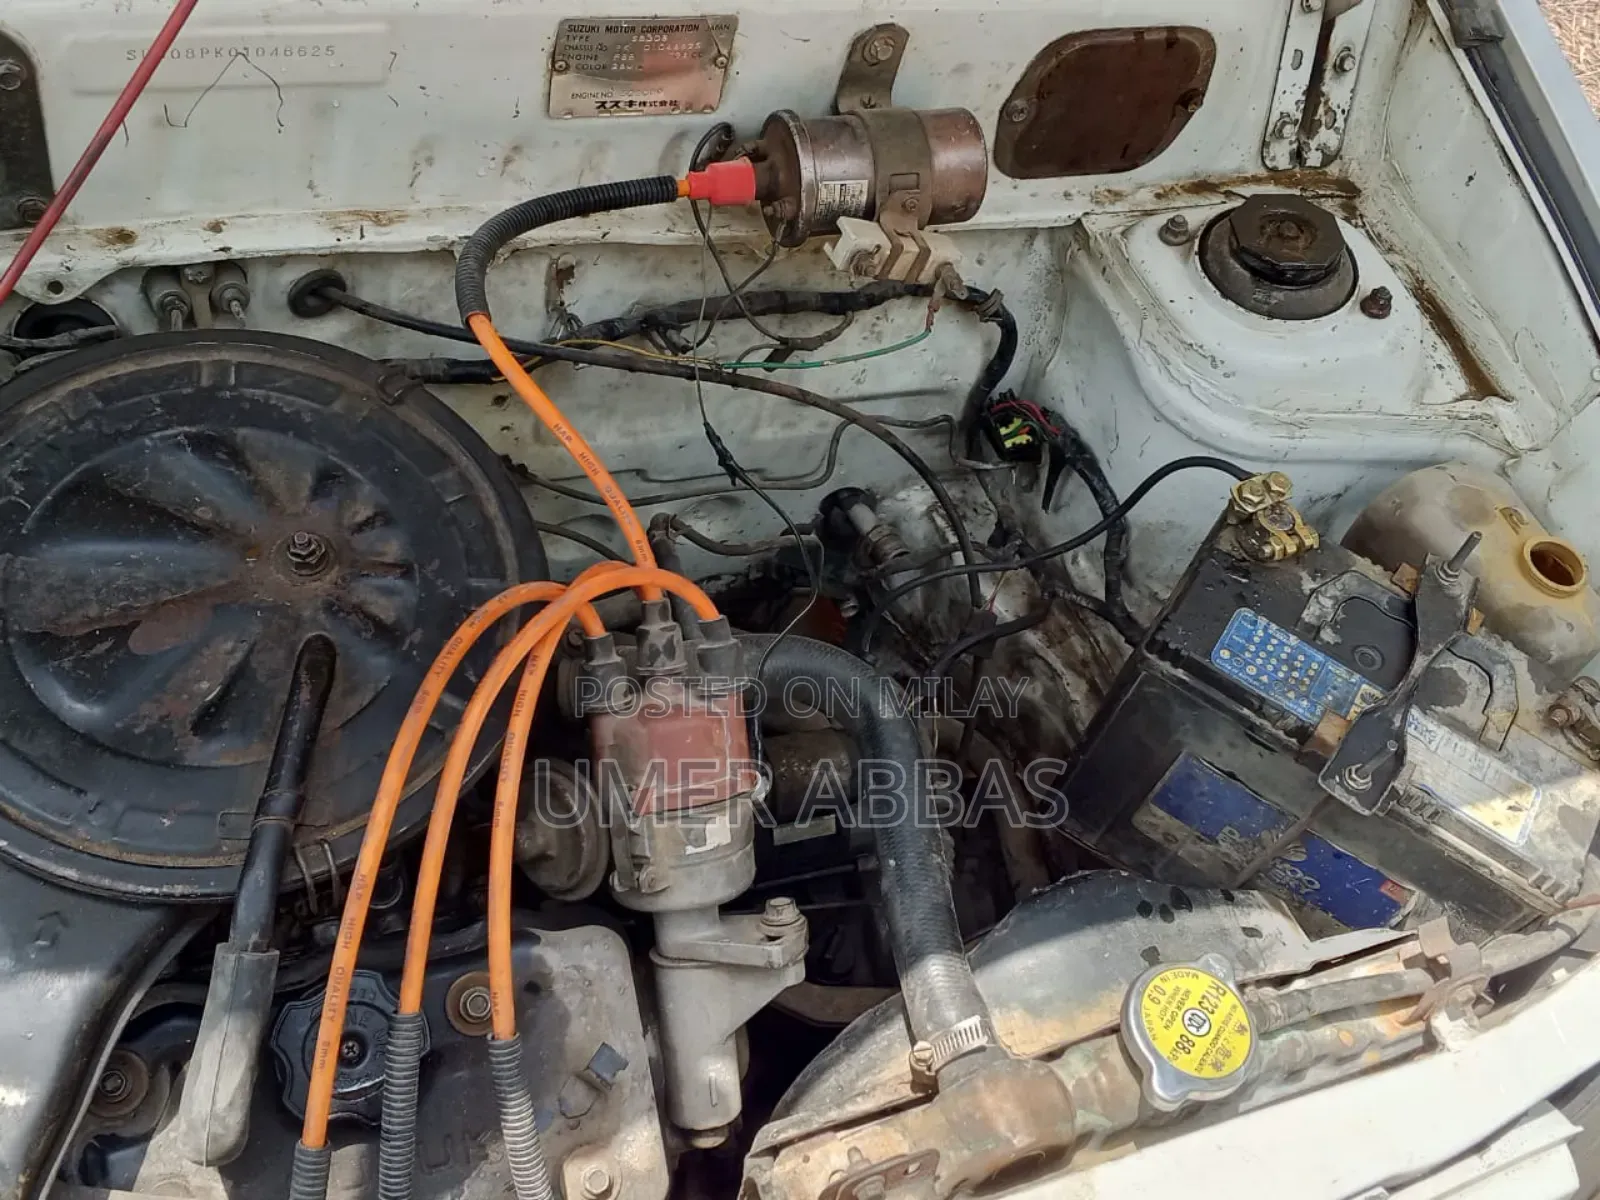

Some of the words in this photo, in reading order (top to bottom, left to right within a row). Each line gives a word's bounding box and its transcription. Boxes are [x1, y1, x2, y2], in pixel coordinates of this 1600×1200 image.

[564, 34, 591, 42] TYPE
[567, 24, 600, 33] SUZUKI
[605, 25, 636, 34] MOTOR
[640, 24, 699, 34] CORPORATION
[126, 44, 336, 61] S08PK01046625
[574, 63, 607, 71] COLOR
[579, 452, 600, 476] HIGH
[604, 482, 632, 525] QUALITY
[434, 636, 463, 678] QUALITY
[513, 689, 528, 717] HIGH
[341, 916, 357, 950] HIGH
[1160, 975, 1171, 984] IN
[1172, 971, 1199, 980] MADE
[326, 966, 345, 1023] QUALITY
[1176, 988, 1192, 1011] NEVER
[1198, 980, 1228, 1015] R123
[1159, 1005, 1169, 1022] HOT
[1163, 1010, 1179, 1031] OPEN
